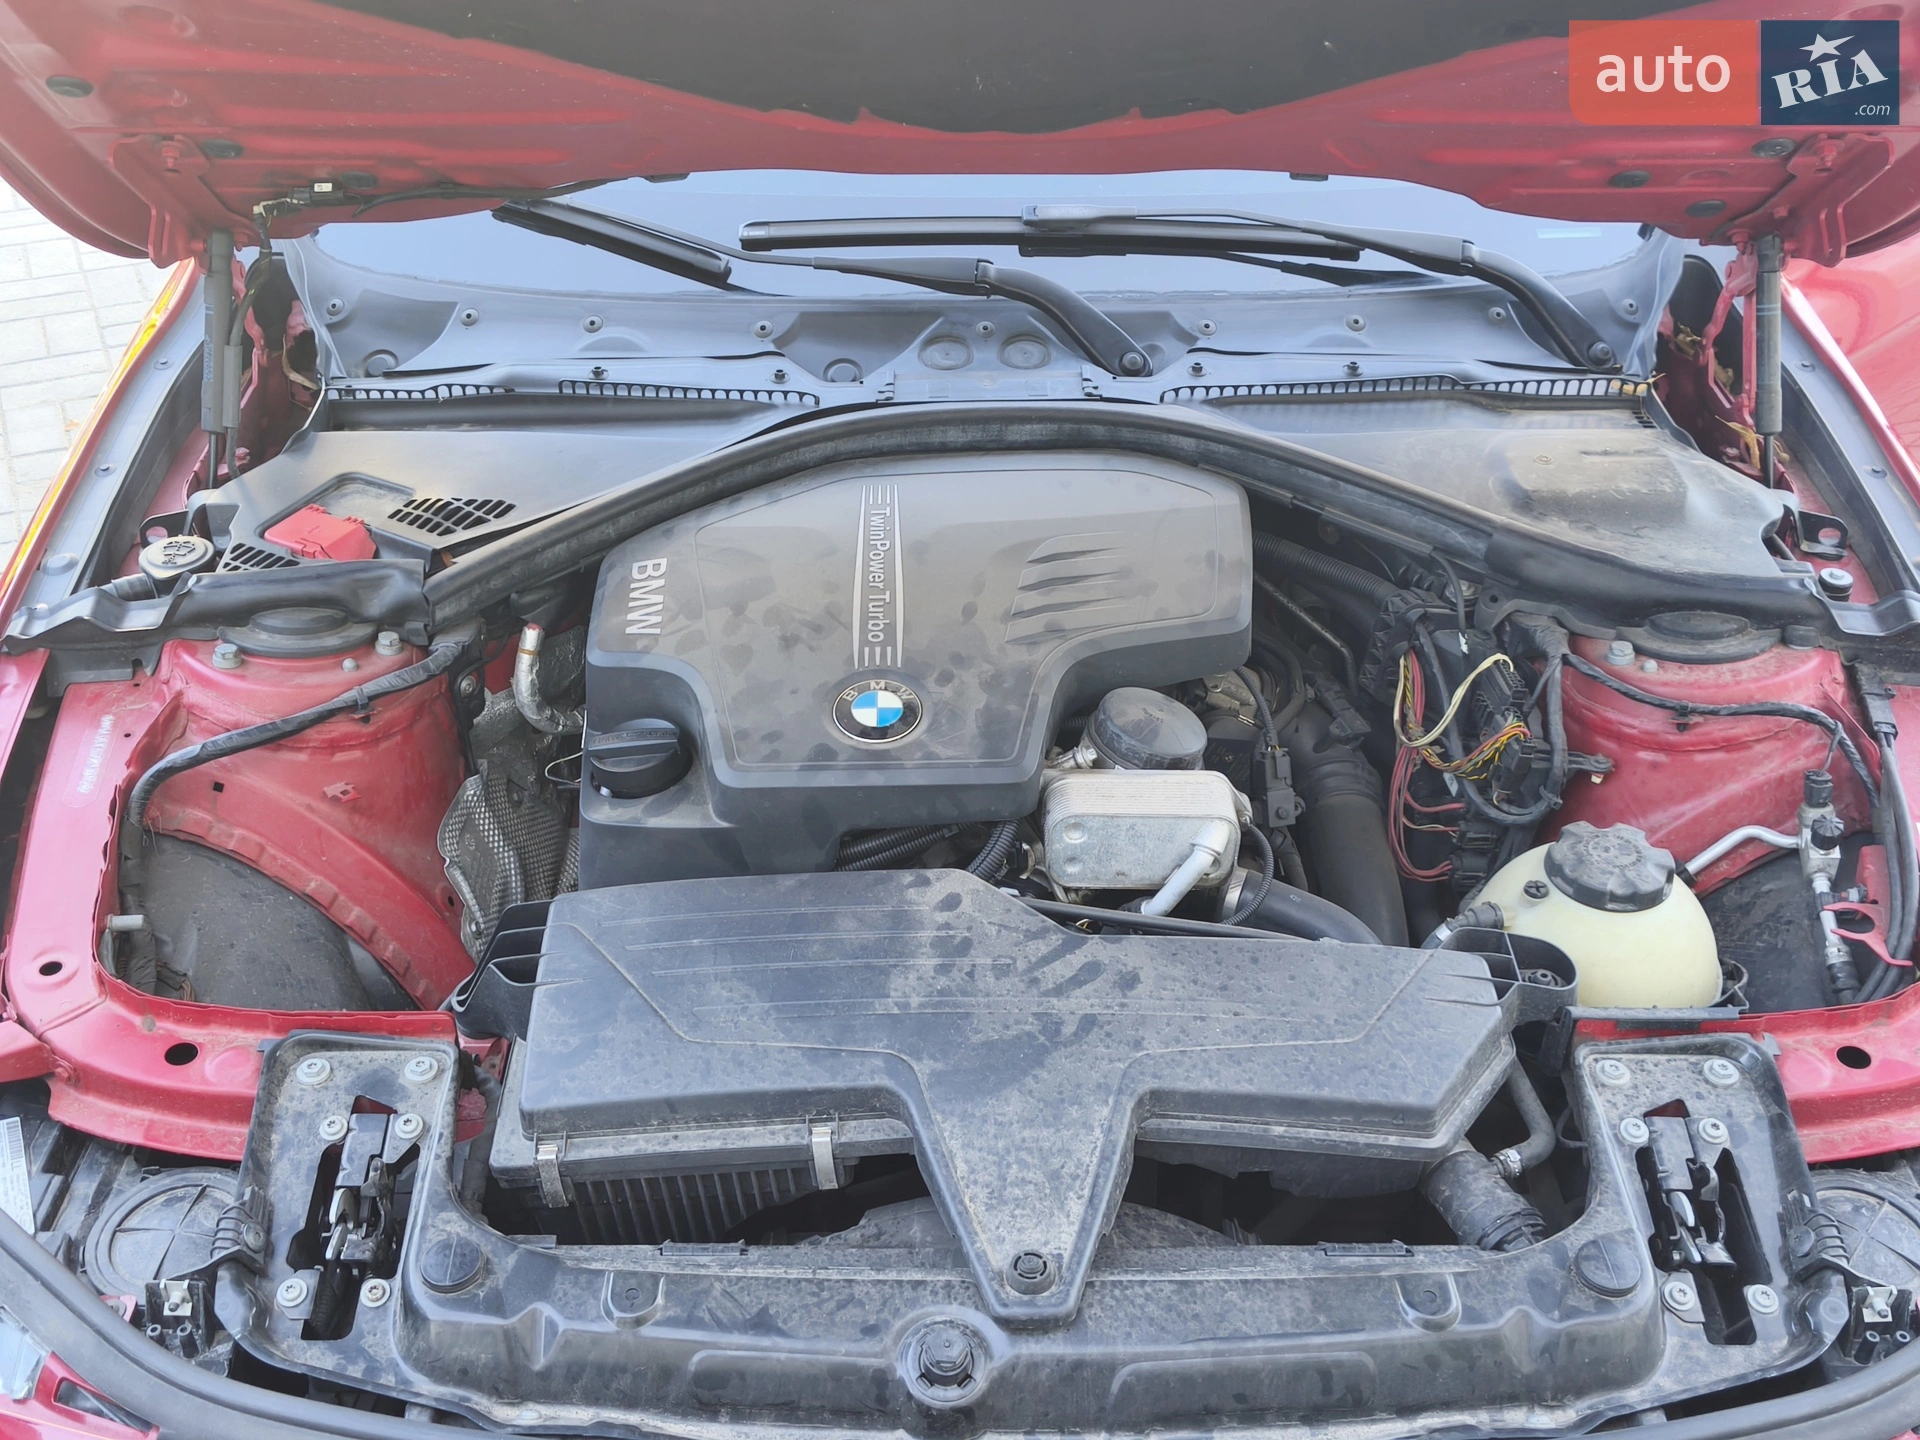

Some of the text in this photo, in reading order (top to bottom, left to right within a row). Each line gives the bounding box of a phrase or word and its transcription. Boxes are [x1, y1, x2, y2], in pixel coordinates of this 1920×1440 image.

[625, 557, 668, 635] BMW
[867, 506, 891, 643] TwinPower Turbo
[842, 680, 914, 702] BMW
